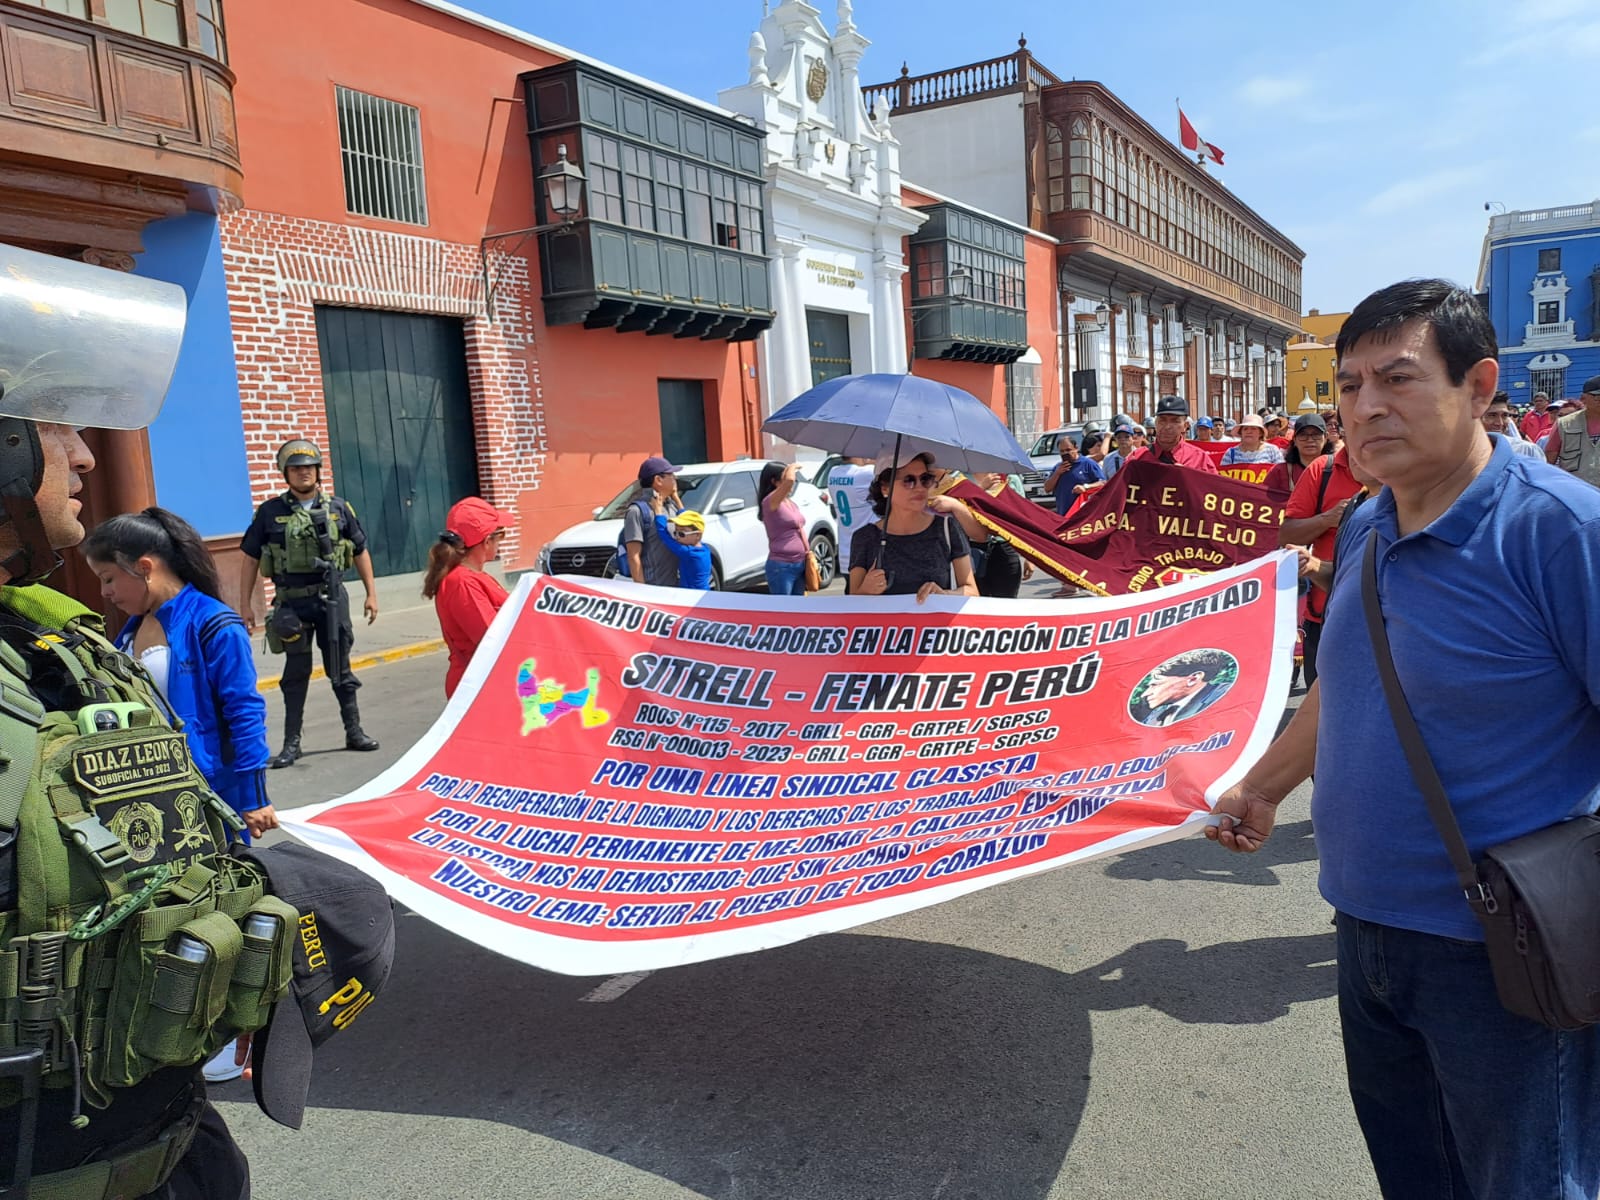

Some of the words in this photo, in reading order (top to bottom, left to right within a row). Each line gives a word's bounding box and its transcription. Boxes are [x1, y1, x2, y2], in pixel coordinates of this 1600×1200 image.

[836, 490, 852, 527] 9
[1158, 515, 1257, 546] VALLEJO
[1154, 547, 1225, 566] TRABAJO
[536, 587, 646, 631] SINDICATO
[645, 611, 678, 637] DE
[678, 618, 846, 654] TRABAJADORES
[848, 628, 882, 654] EN
[882, 628, 914, 655] LA
[918, 624, 1055, 655] EDUCACIÓN
[1057, 624, 1092, 650] DE
[1098, 617, 1129, 644] LA
[1137, 579, 1261, 634] LIBERTAD
[623, 653, 775, 708] SITRELL
[812, 673, 971, 711] FENATE
[979, 654, 1101, 708] PERÚ
[609, 729, 644, 747] RSG
[743, 745, 792, 762] 2023
[806, 746, 848, 763] GRLL
[864, 744, 903, 761] GGR
[919, 740, 977, 758] GRTPE
[994, 727, 1058, 750] SGPSC
[743, 722, 788, 739] 2017
[799, 723, 841, 740] GRLL
[858, 724, 896, 739] GGR
[911, 720, 968, 738] GRTPE
[987, 709, 1049, 731] SGPSC
[82, 747, 132, 775] DIAZ
[134, 741, 170, 765] LEON
[94, 769, 142, 787] SUBOFICIAL
[593, 760, 649, 788] POR
[648, 766, 704, 795] UNA
[705, 773, 778, 798] LINEA
[781, 772, 898, 798] SINDICAL
[906, 753, 1038, 789] CLASISTA
[419, 774, 455, 798] POR
[452, 780, 481, 800] LA
[474, 784, 592, 820] RECUPERACIÓN
[586, 799, 614, 821] DE
[610, 801, 637, 824] LA
[633, 804, 712, 830] DIGNIDAD
[711, 809, 729, 832] Y
[725, 810, 761, 832] LOS
[759, 806, 848, 831] DERECHOS
[847, 802, 873, 824] DE
[873, 799, 911, 820] LOS
[1054, 769, 1084, 787] EN
[1086, 764, 1114, 781] LA
[131, 832, 150, 849] PNP
[427, 808, 480, 831] POR
[475, 820, 510, 842] LA
[505, 826, 580, 855] LUCHA
[576, 835, 722, 863] PERMANENTE
[721, 841, 756, 862] DE
[755, 829, 868, 860] MEJORAR
[868, 822, 905, 842] LA
[906, 804, 1016, 837] CALIDAD
[411, 828, 448, 846] LA
[529, 864, 575, 888] NOS
[571, 867, 606, 890] HA
[746, 862, 793, 887] QUE
[791, 858, 832, 880] SIN
[432, 857, 538, 912] NUESTRO
[607, 904, 692, 927] SERVIR
[688, 900, 722, 923] AL
[722, 886, 816, 917] PUEBLO
[814, 879, 853, 903] DE
[855, 865, 925, 895] TODO
[298, 911, 328, 973] PERU
